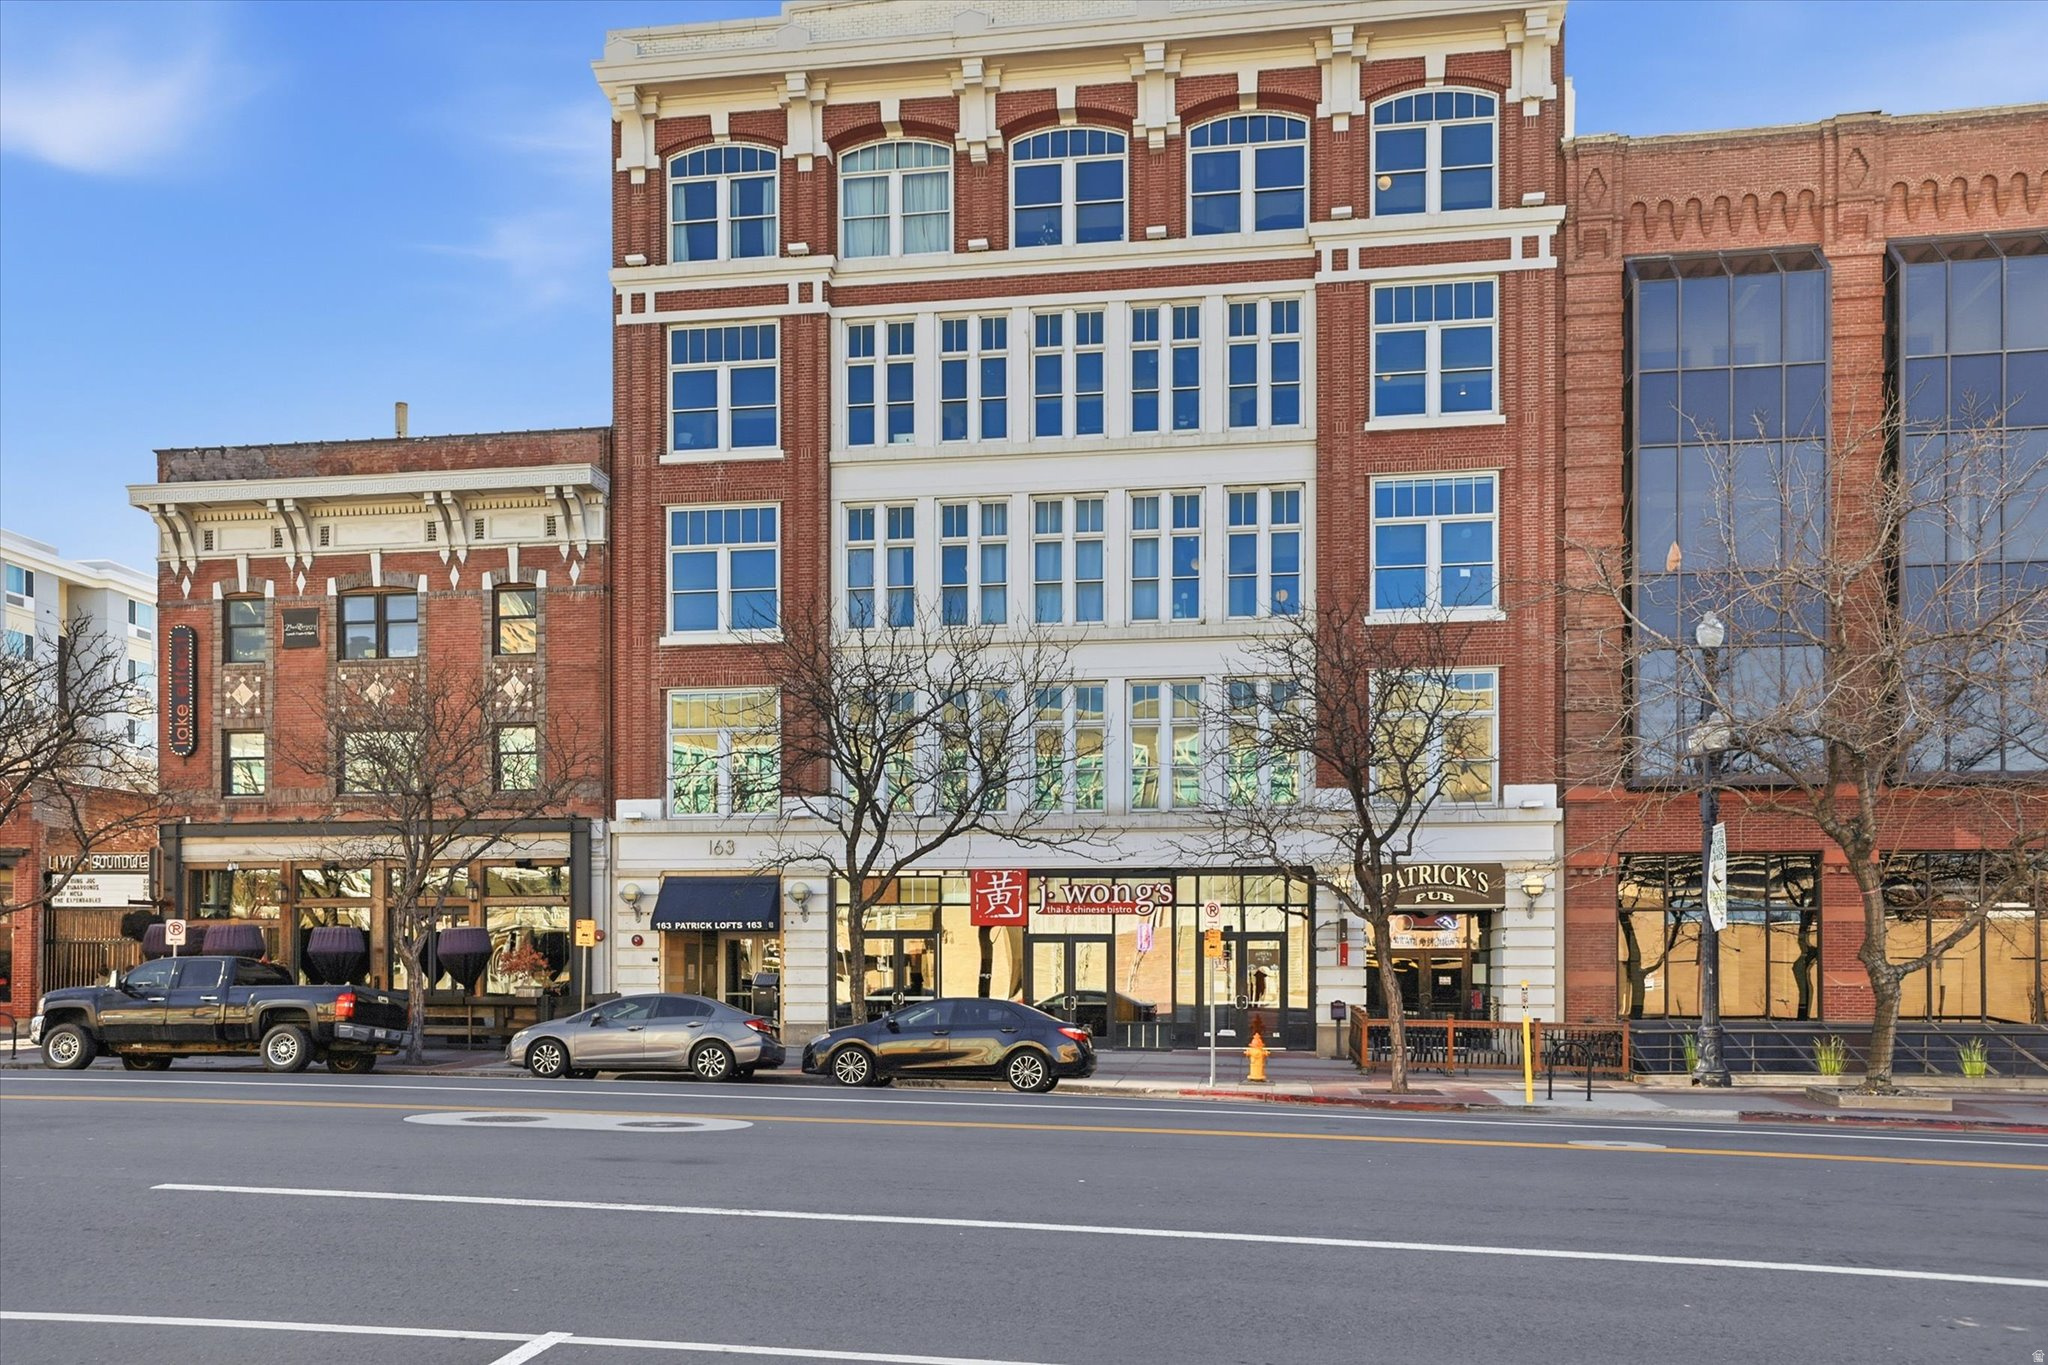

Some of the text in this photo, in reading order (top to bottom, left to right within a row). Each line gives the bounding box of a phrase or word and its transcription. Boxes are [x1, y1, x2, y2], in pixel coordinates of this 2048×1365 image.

[174, 704, 189, 746] lake
[709, 839, 735, 856] 163
[1381, 864, 1489, 894] PATRICK'S
[1060, 882, 1173, 916] wong's
[1414, 891, 1455, 904] PUB
[1046, 905, 1132, 914] thai & chinese bistro
[656, 921, 763, 930] 163 PATRICK LOFTS 163
